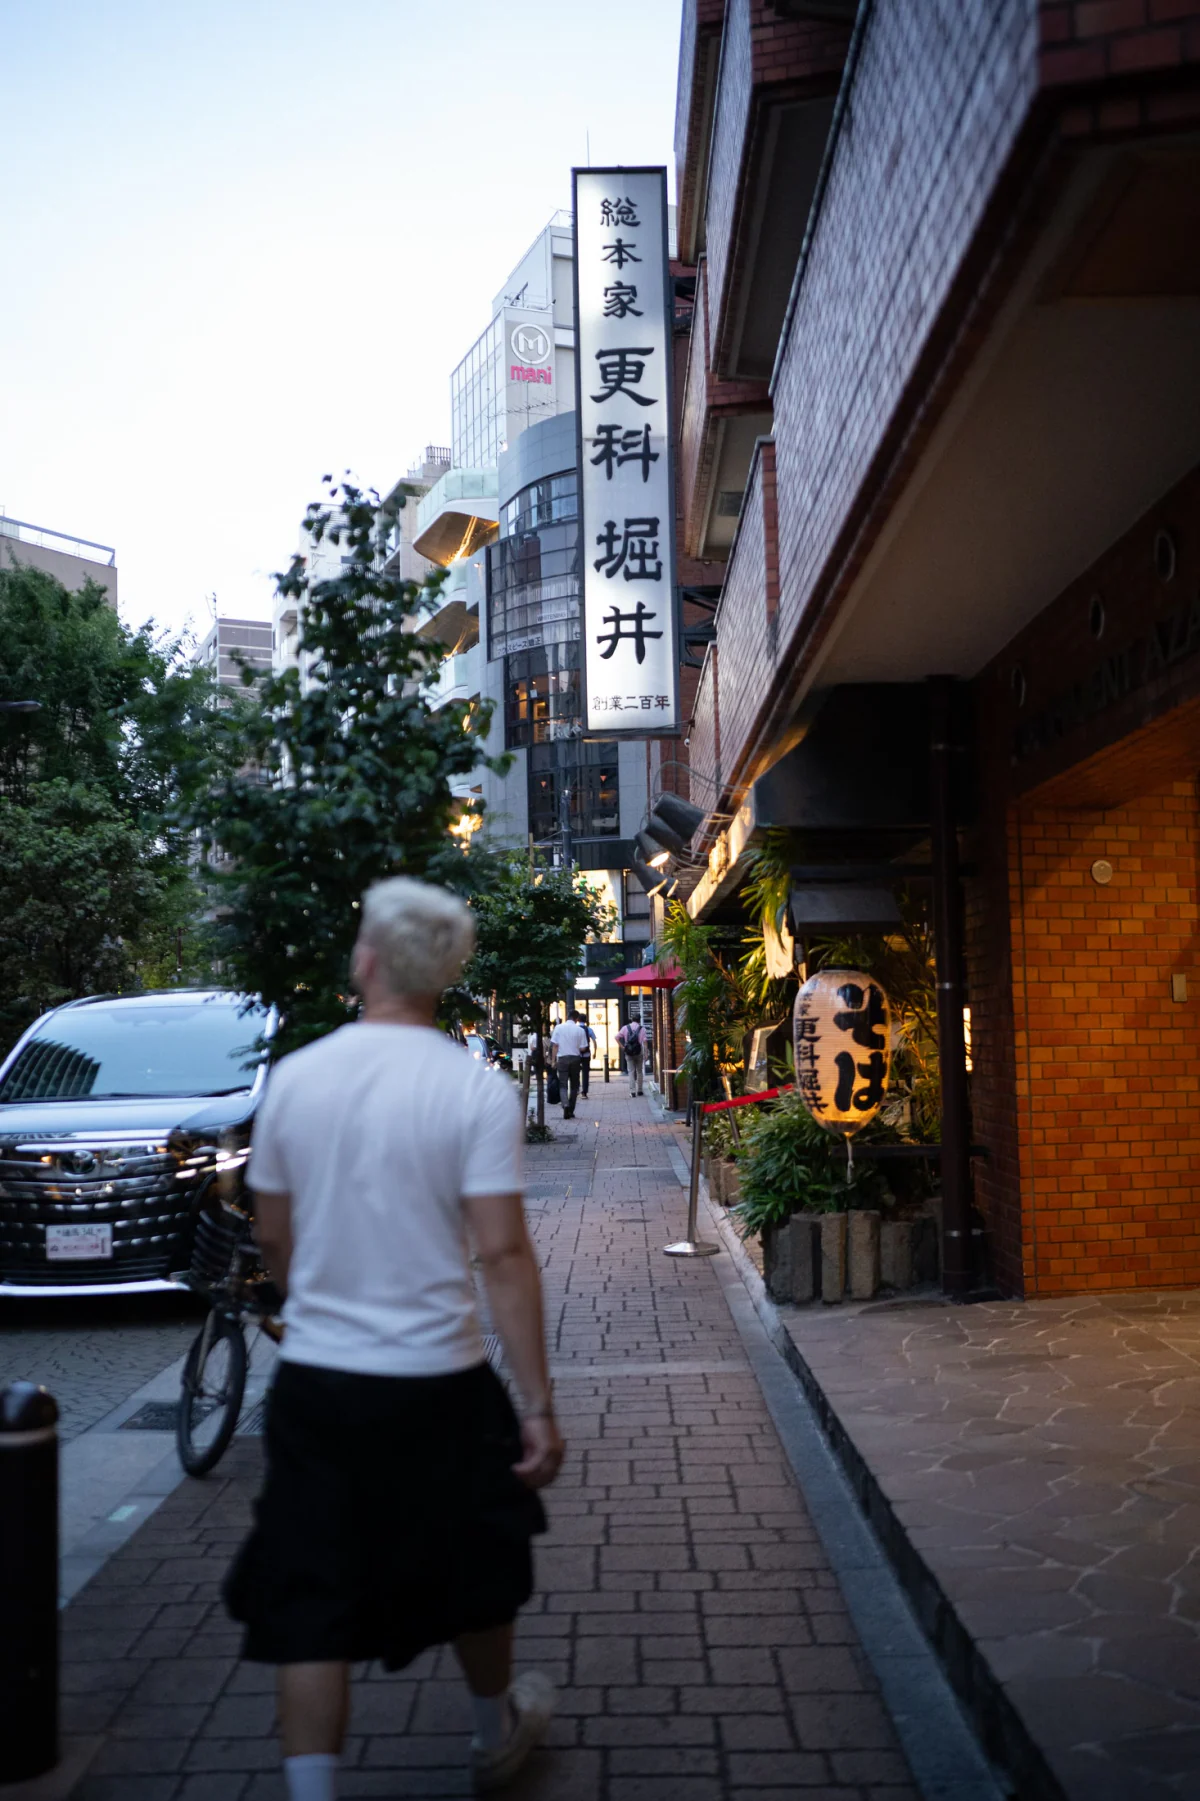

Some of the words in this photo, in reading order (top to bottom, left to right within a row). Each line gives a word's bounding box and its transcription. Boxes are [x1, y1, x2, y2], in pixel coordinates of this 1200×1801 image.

[510, 365, 552, 385] mani
[592, 694, 671, 711] 創業二百年
